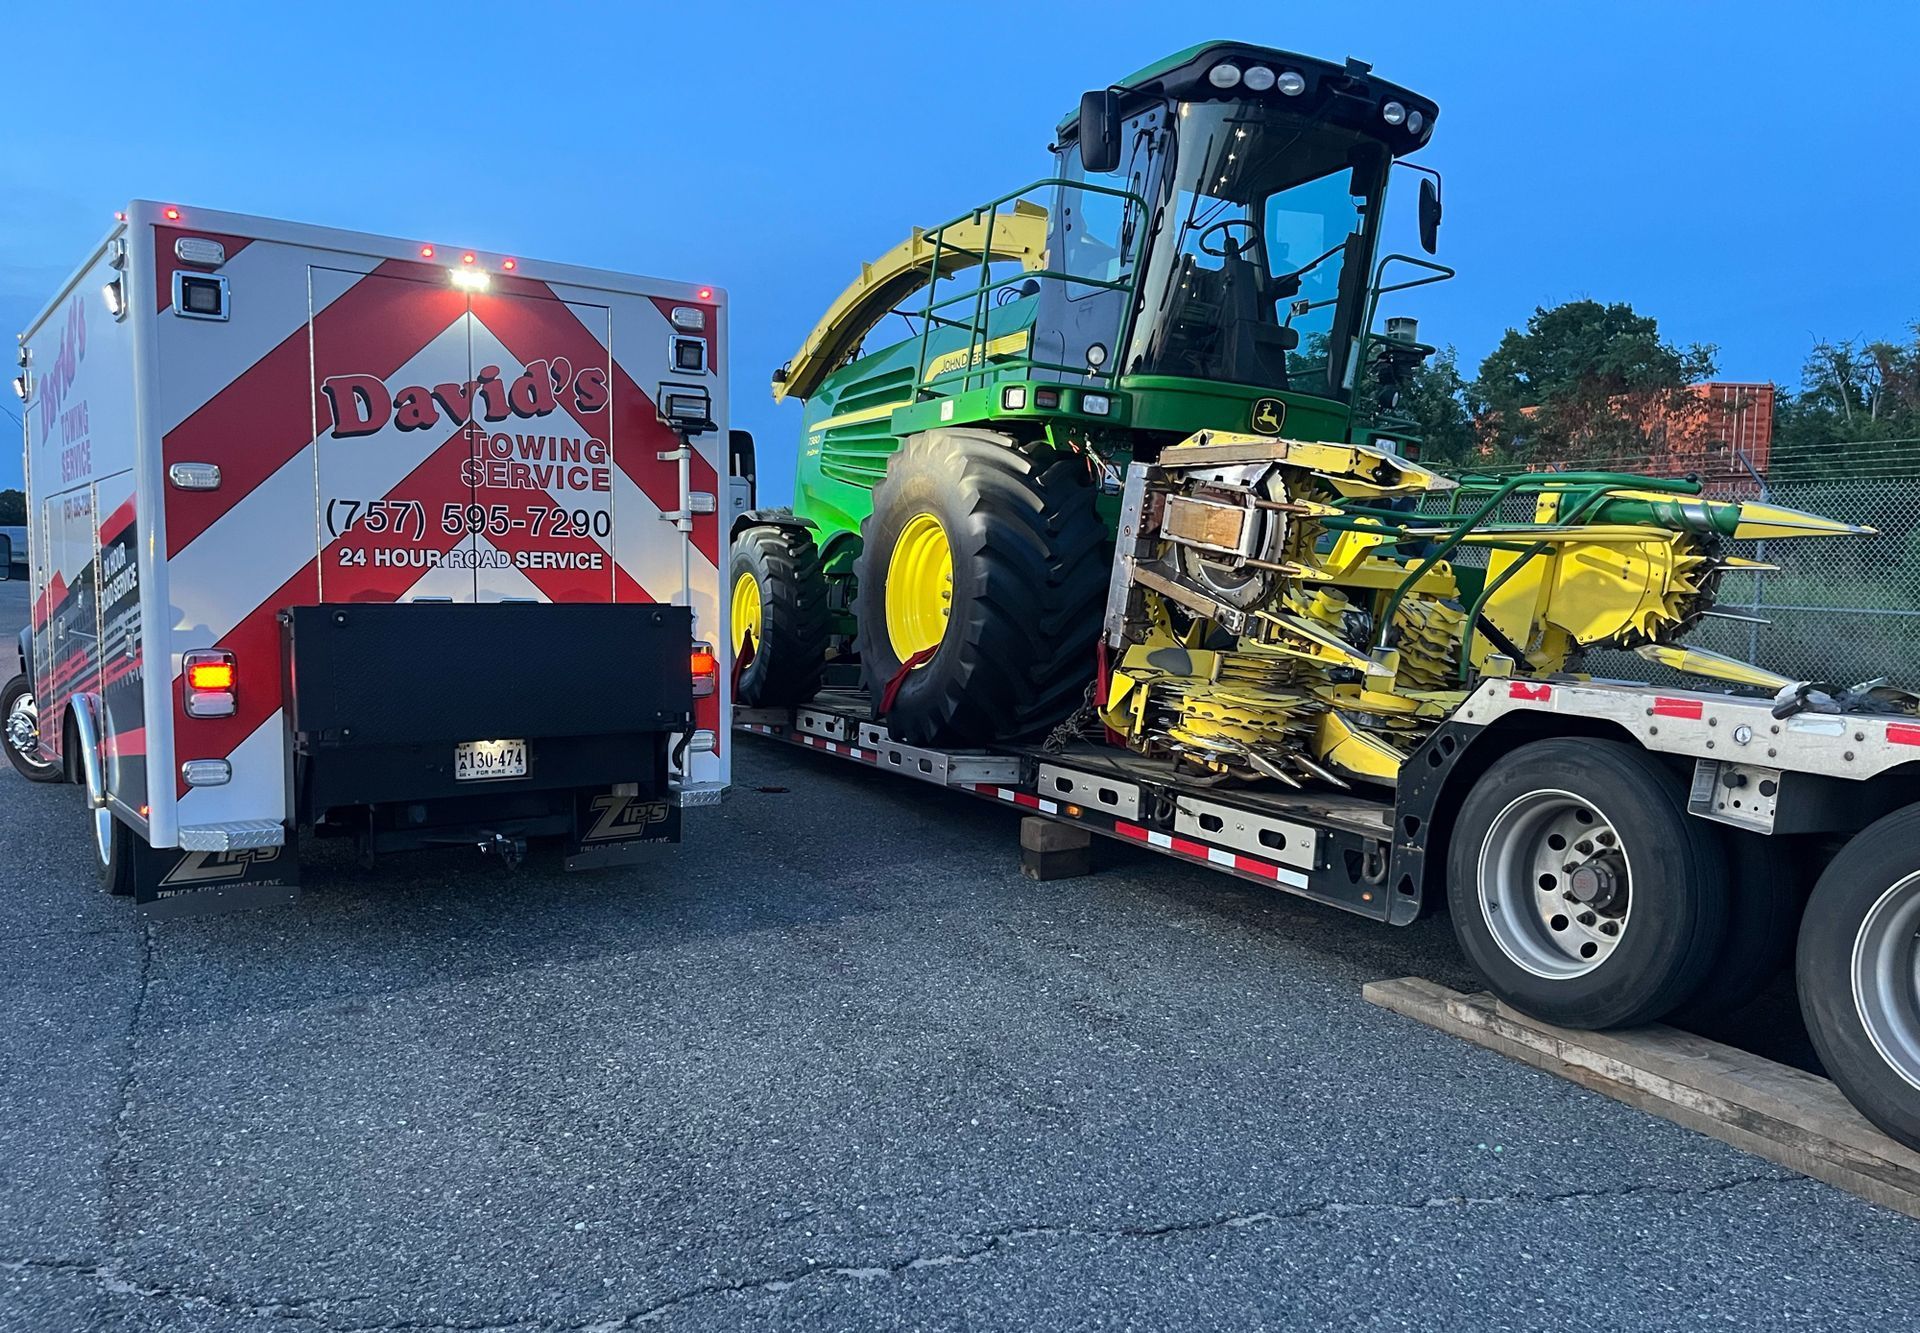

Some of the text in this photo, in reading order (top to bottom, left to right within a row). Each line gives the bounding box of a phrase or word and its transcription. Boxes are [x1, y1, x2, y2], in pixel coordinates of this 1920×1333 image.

[321, 357, 609, 438] David's
[60, 400, 88, 447] TOWING
[61, 439, 91, 483] SERVICE
[464, 430, 606, 464] TOWING
[461, 460, 610, 491] SERVICE
[326, 499, 611, 540] (757) 595-7290
[339, 548, 603, 570] 24 HOUR ROAD SERVICE
[470, 749, 522, 768] 130-474
